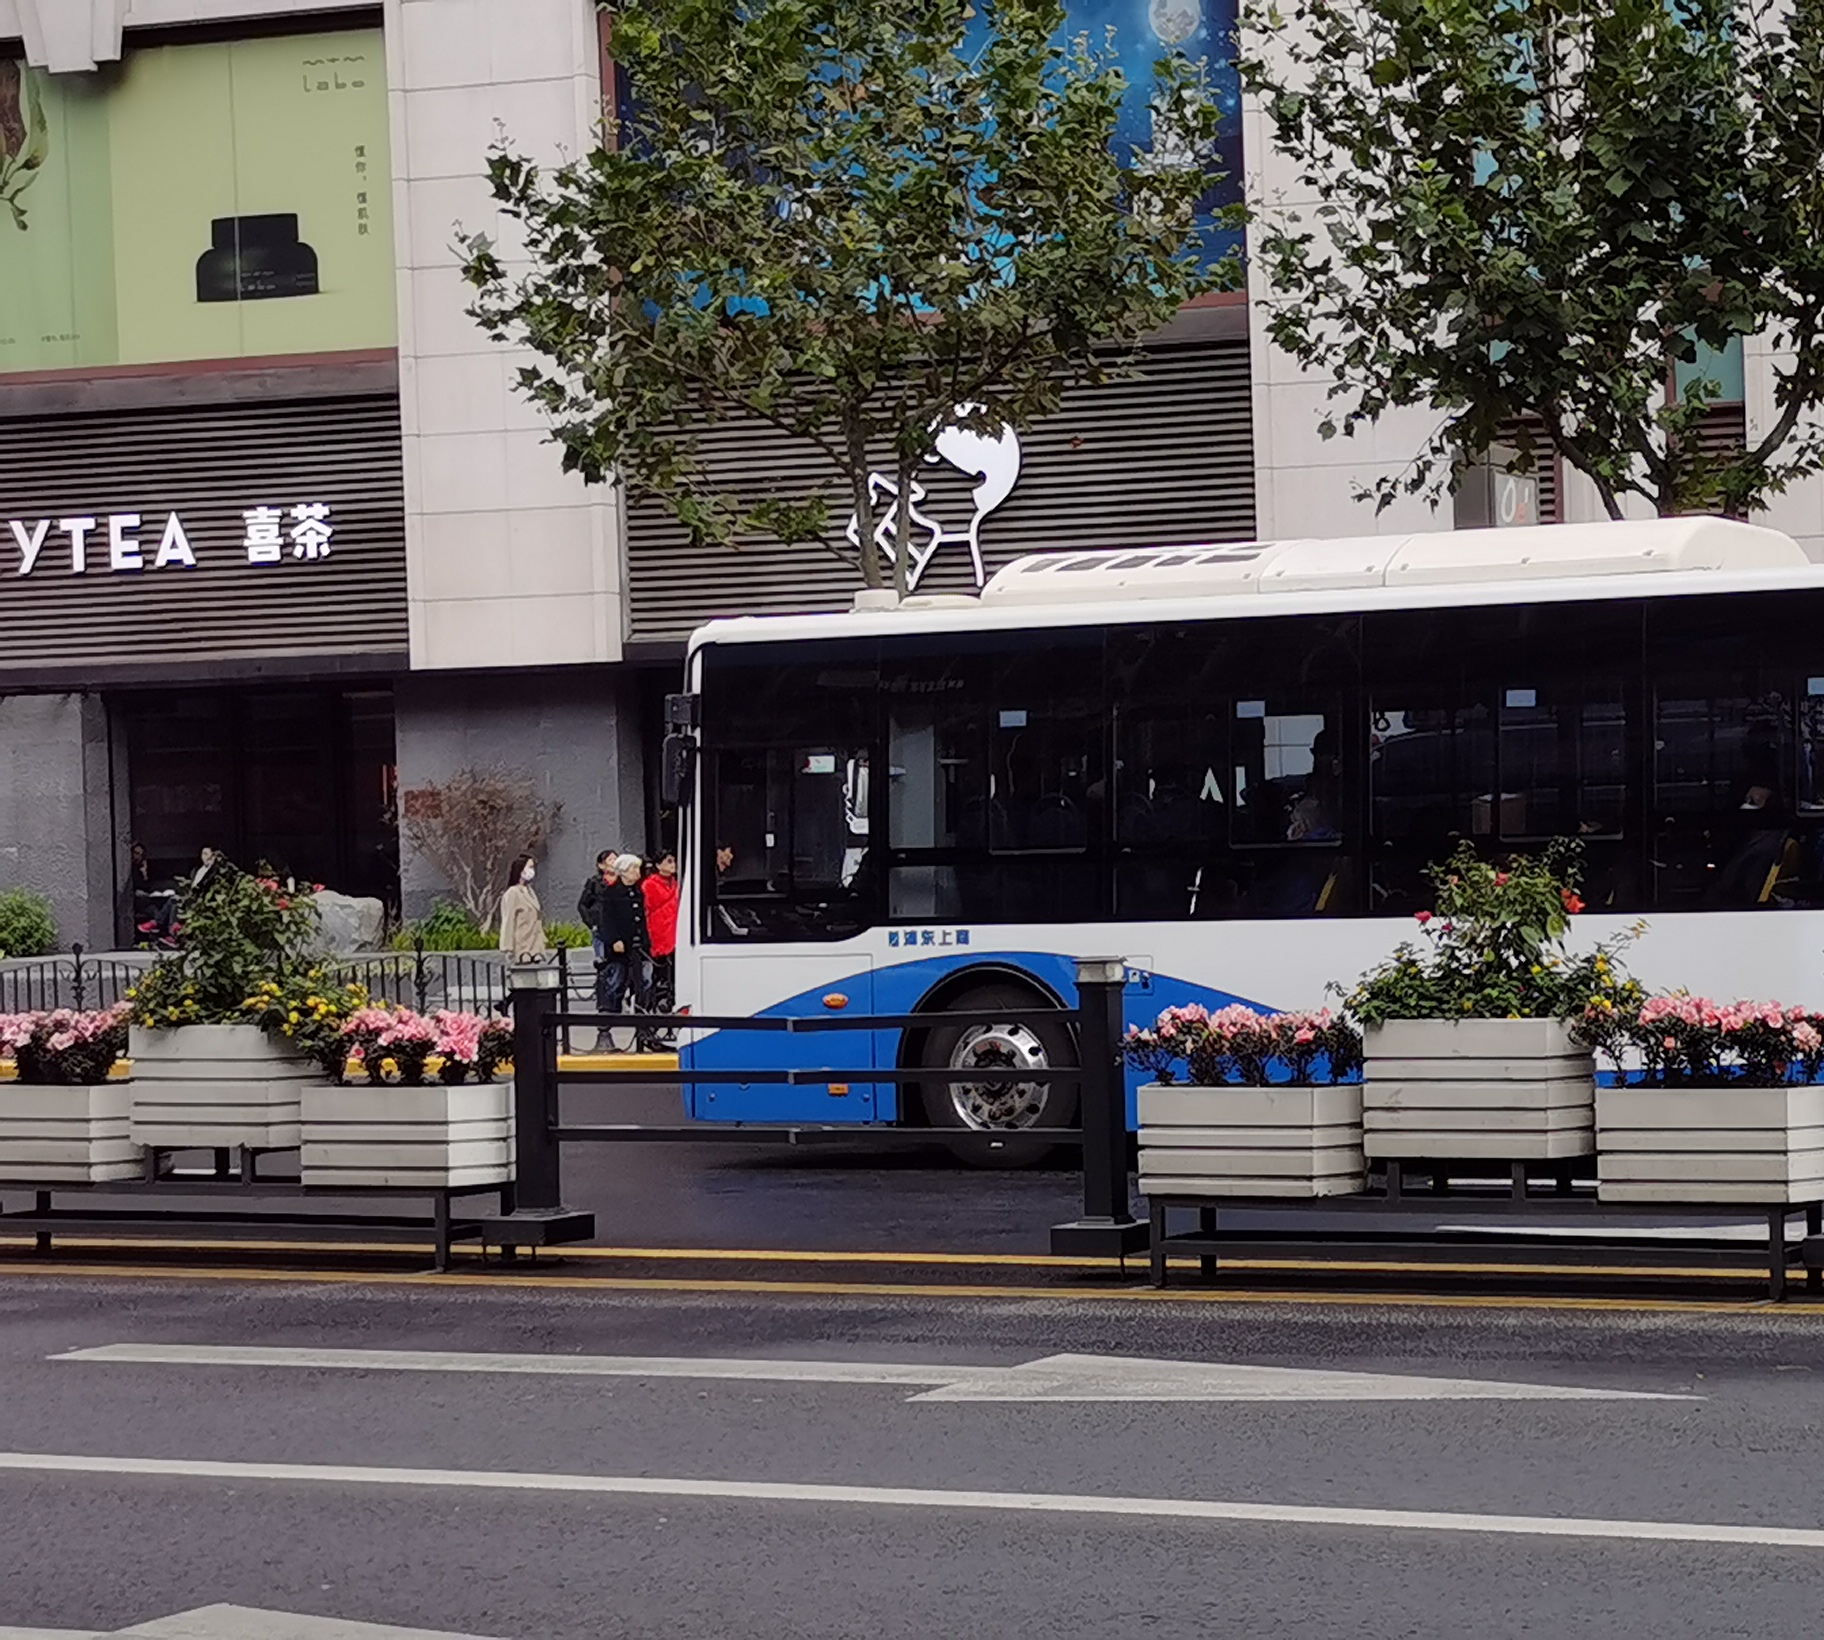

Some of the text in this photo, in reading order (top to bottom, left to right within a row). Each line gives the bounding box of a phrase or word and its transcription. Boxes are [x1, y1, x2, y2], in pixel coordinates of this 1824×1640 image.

[302, 71, 365, 92] labo
[9, 502, 335, 575] YTEA 喜茶
